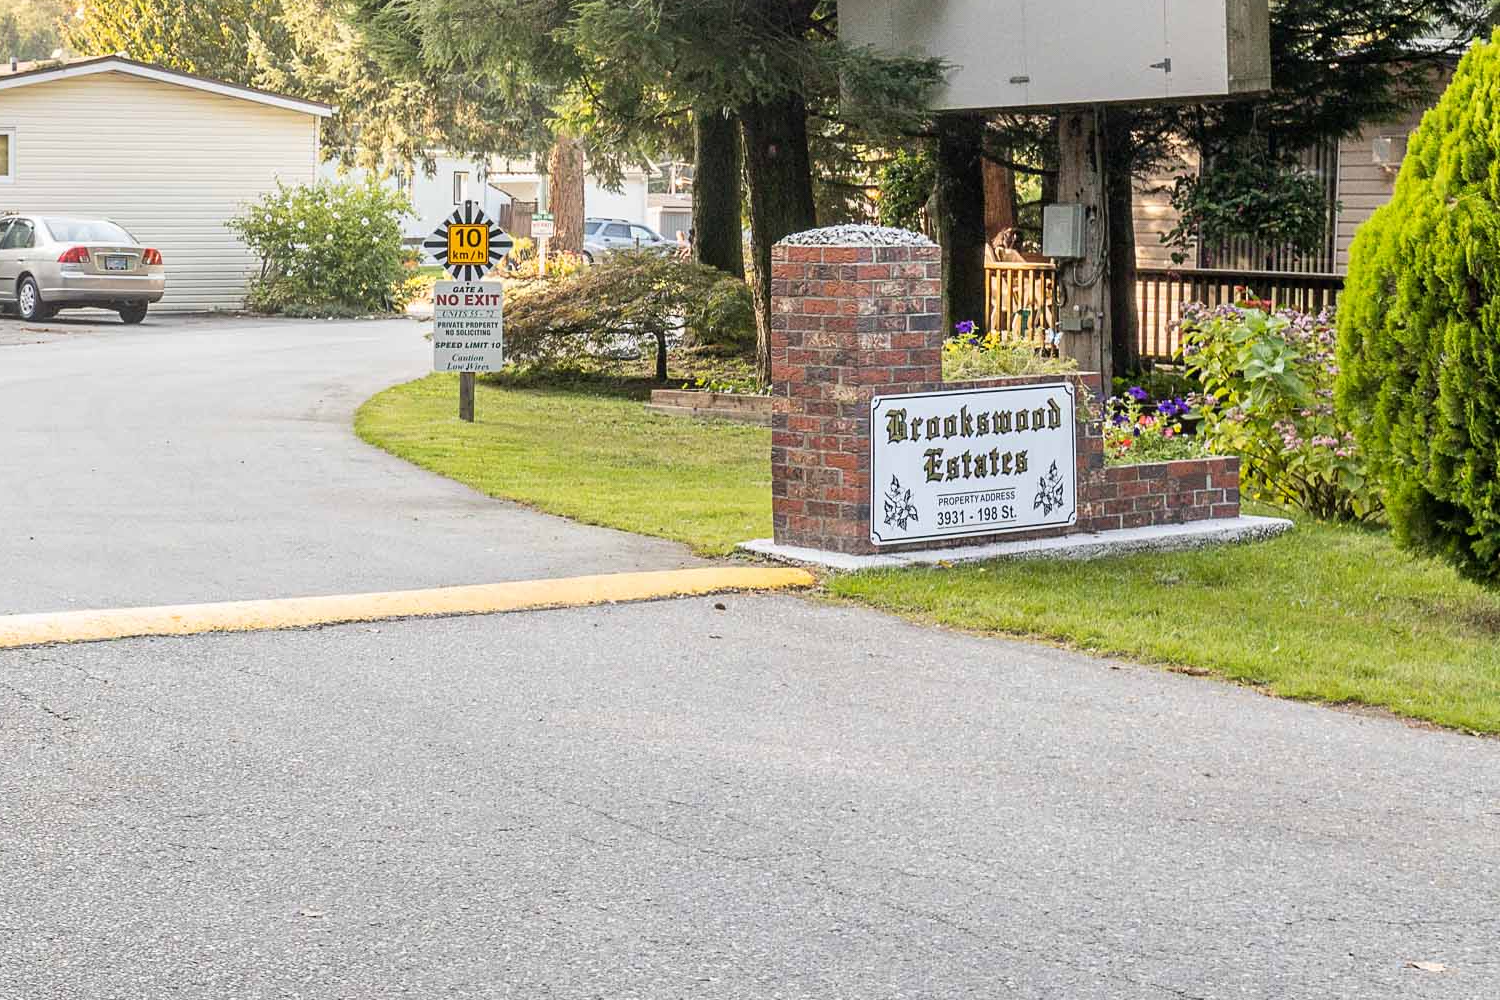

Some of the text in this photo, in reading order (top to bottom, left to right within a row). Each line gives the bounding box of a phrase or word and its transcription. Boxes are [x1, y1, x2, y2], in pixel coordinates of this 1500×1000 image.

[455, 228, 482, 247] 10
[452, 250, 484, 261] km/h
[436, 294, 500, 306] NO EXIT
[452, 353, 484, 361] Caution
[447, 362, 489, 371] Low Wires
[884, 397, 1062, 445] Brookswood
[923, 447, 1029, 484] Estates
[938, 490, 1016, 507] PROPERTY ADDRESS
[937, 509, 965, 526] 3931
[977, 506, 998, 521] 198
[1001, 504, 1017, 519] St.
